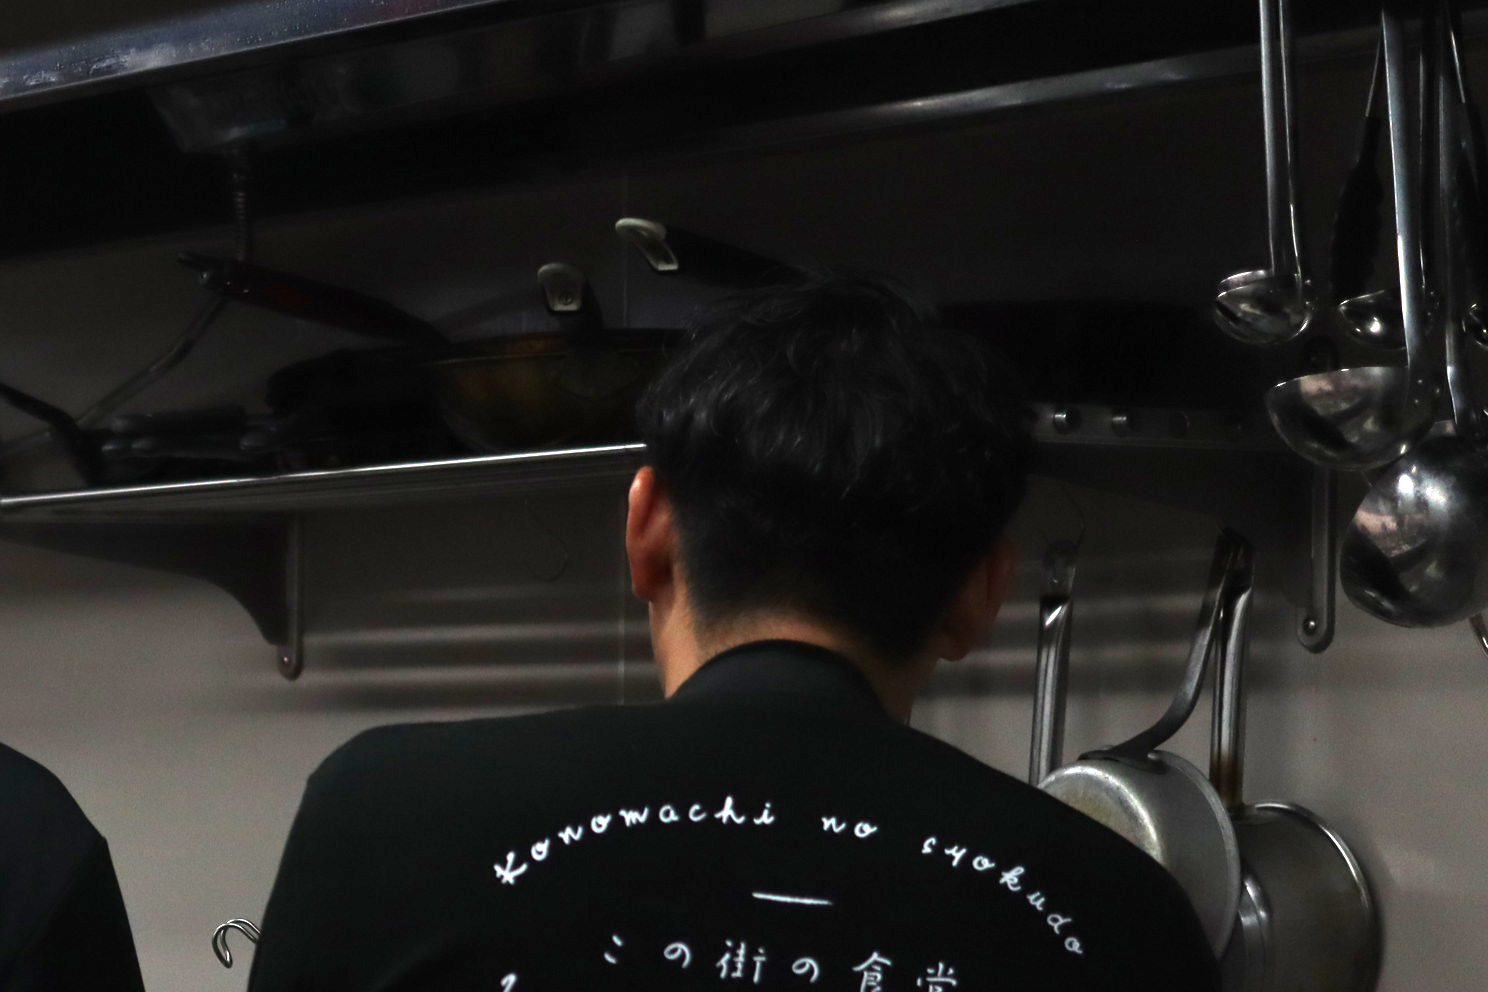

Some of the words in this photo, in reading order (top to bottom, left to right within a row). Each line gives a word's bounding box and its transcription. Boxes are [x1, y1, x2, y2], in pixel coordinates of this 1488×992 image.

[493, 795, 775, 885] Konomachi
[821, 815, 878, 839] no
[921, 835, 1084, 955] syokudo
